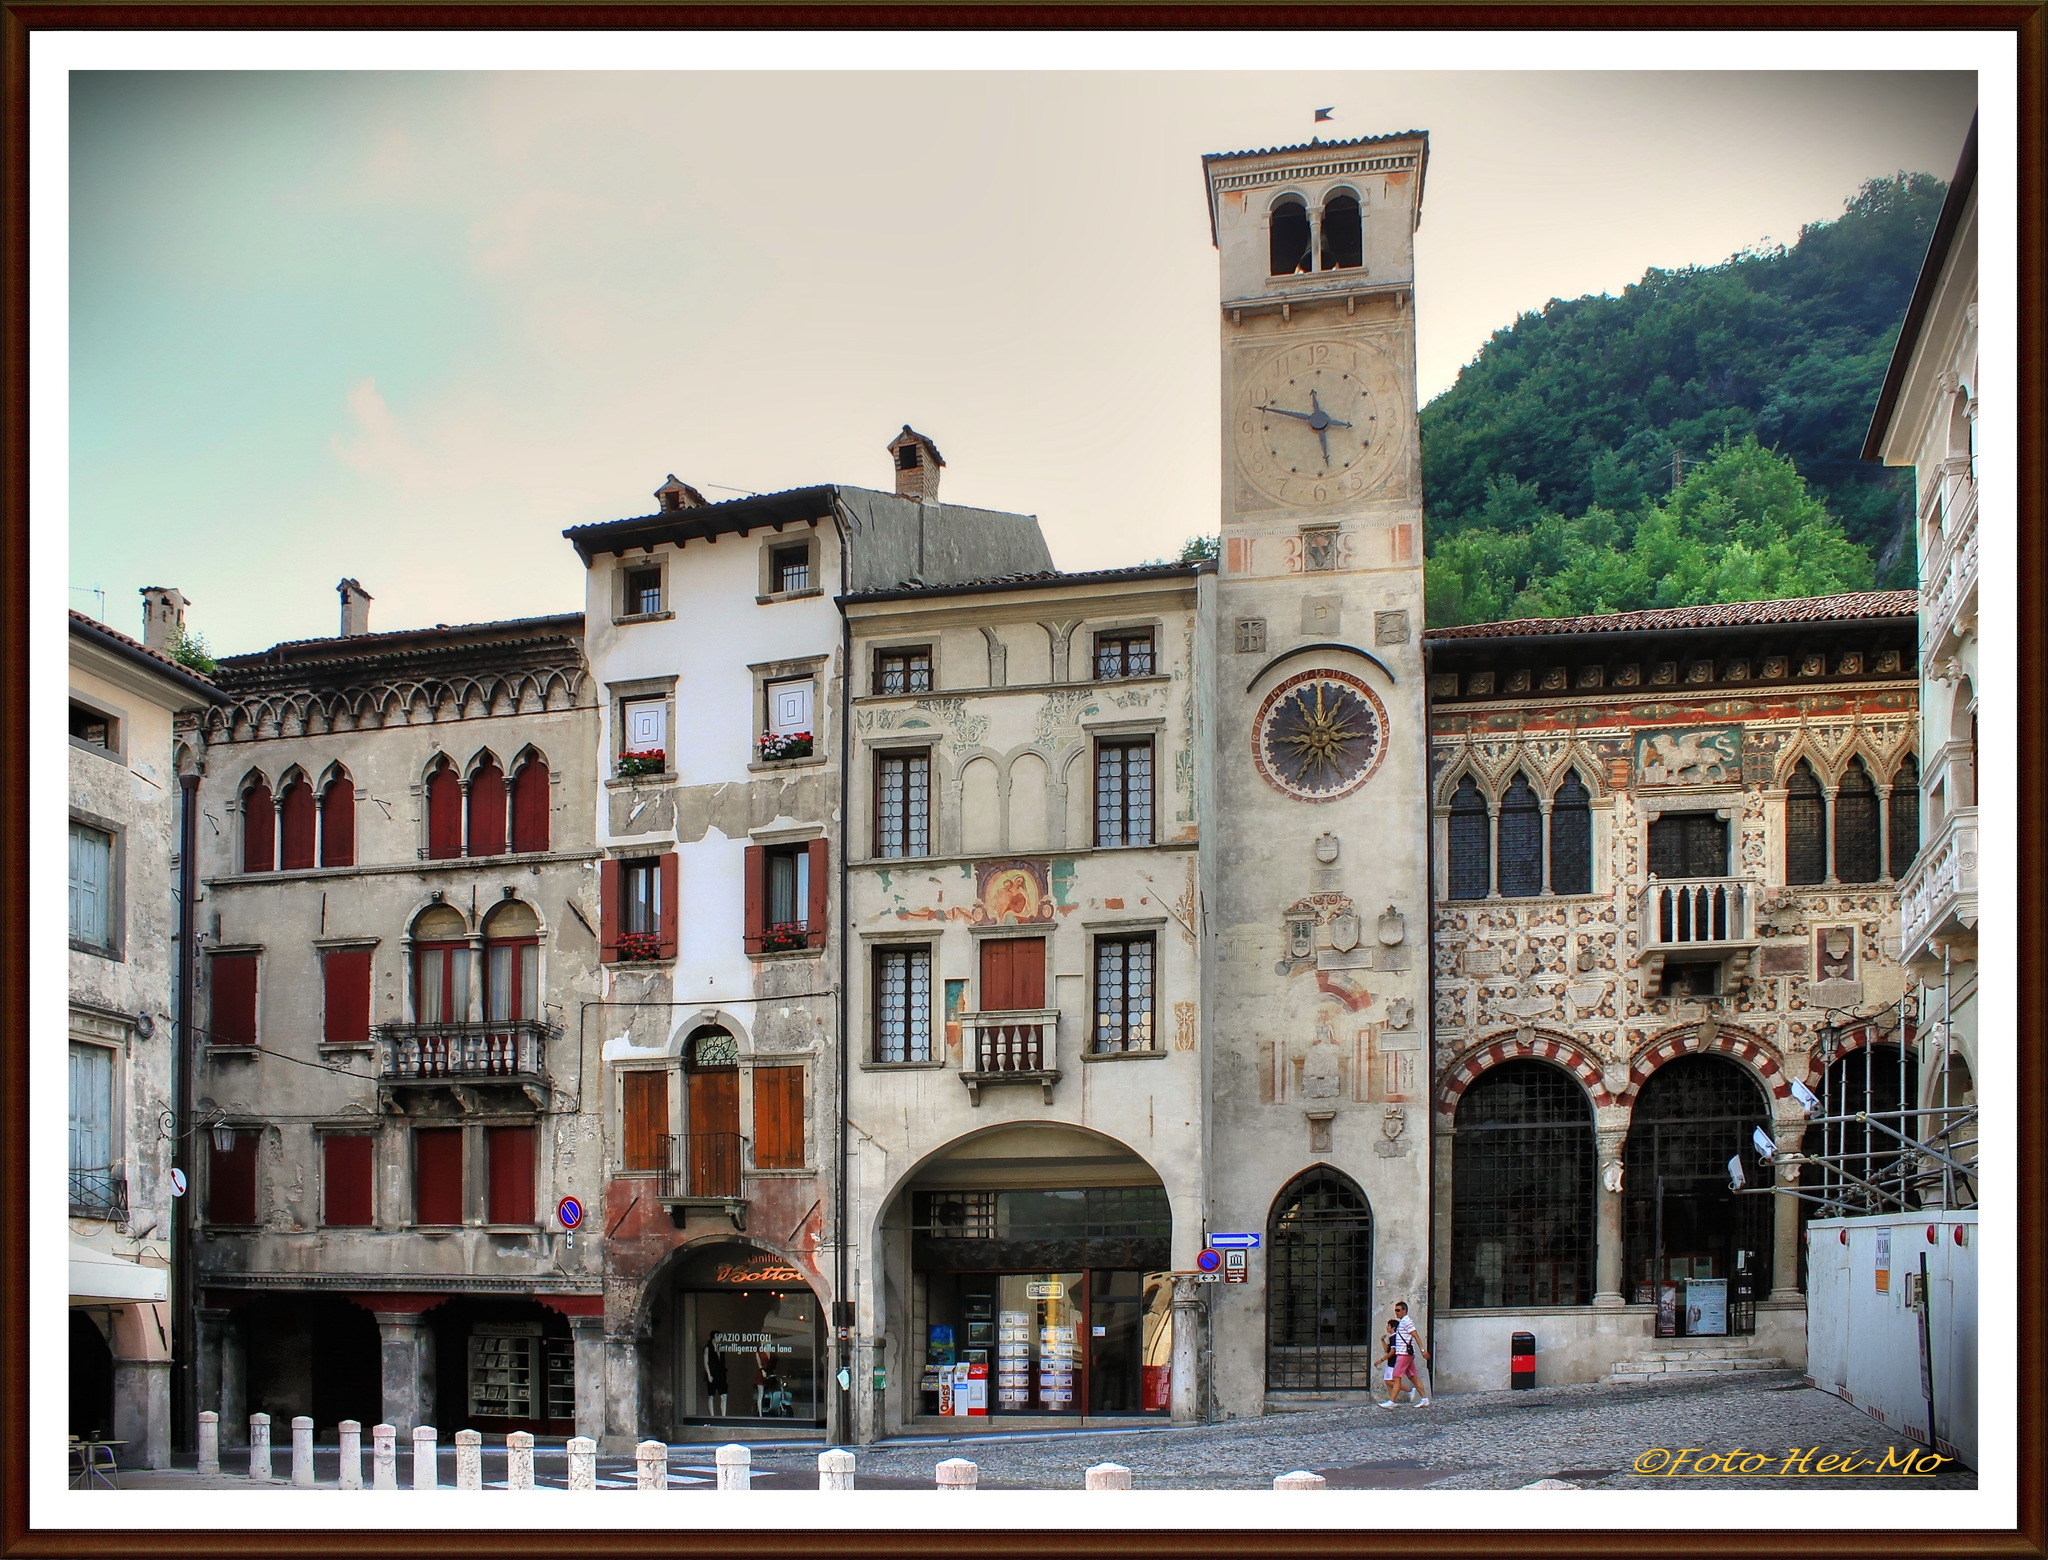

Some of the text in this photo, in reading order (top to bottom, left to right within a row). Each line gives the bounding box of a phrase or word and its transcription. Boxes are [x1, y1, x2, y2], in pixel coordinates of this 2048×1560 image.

[1306, 344, 1329, 366] 12
[1351, 351, 1358, 371] 1
[1273, 356, 1289, 377] 11
[1374, 373, 1391, 394] 2
[1246, 386, 1268, 407] 10
[1384, 407, 1398, 429] 3
[1242, 420, 1254, 438] 9
[1373, 440, 1389, 459] 4
[1252, 450, 1264, 473] 8
[1275, 477, 1291, 497] 7
[1350, 471, 1363, 490] 5
[1313, 482, 1328, 502] 6
[714, 1333, 772, 1342] SPAZIO BOTTOLI
[759, 1343, 776, 1353] della
[777, 1343, 792, 1353] lana
